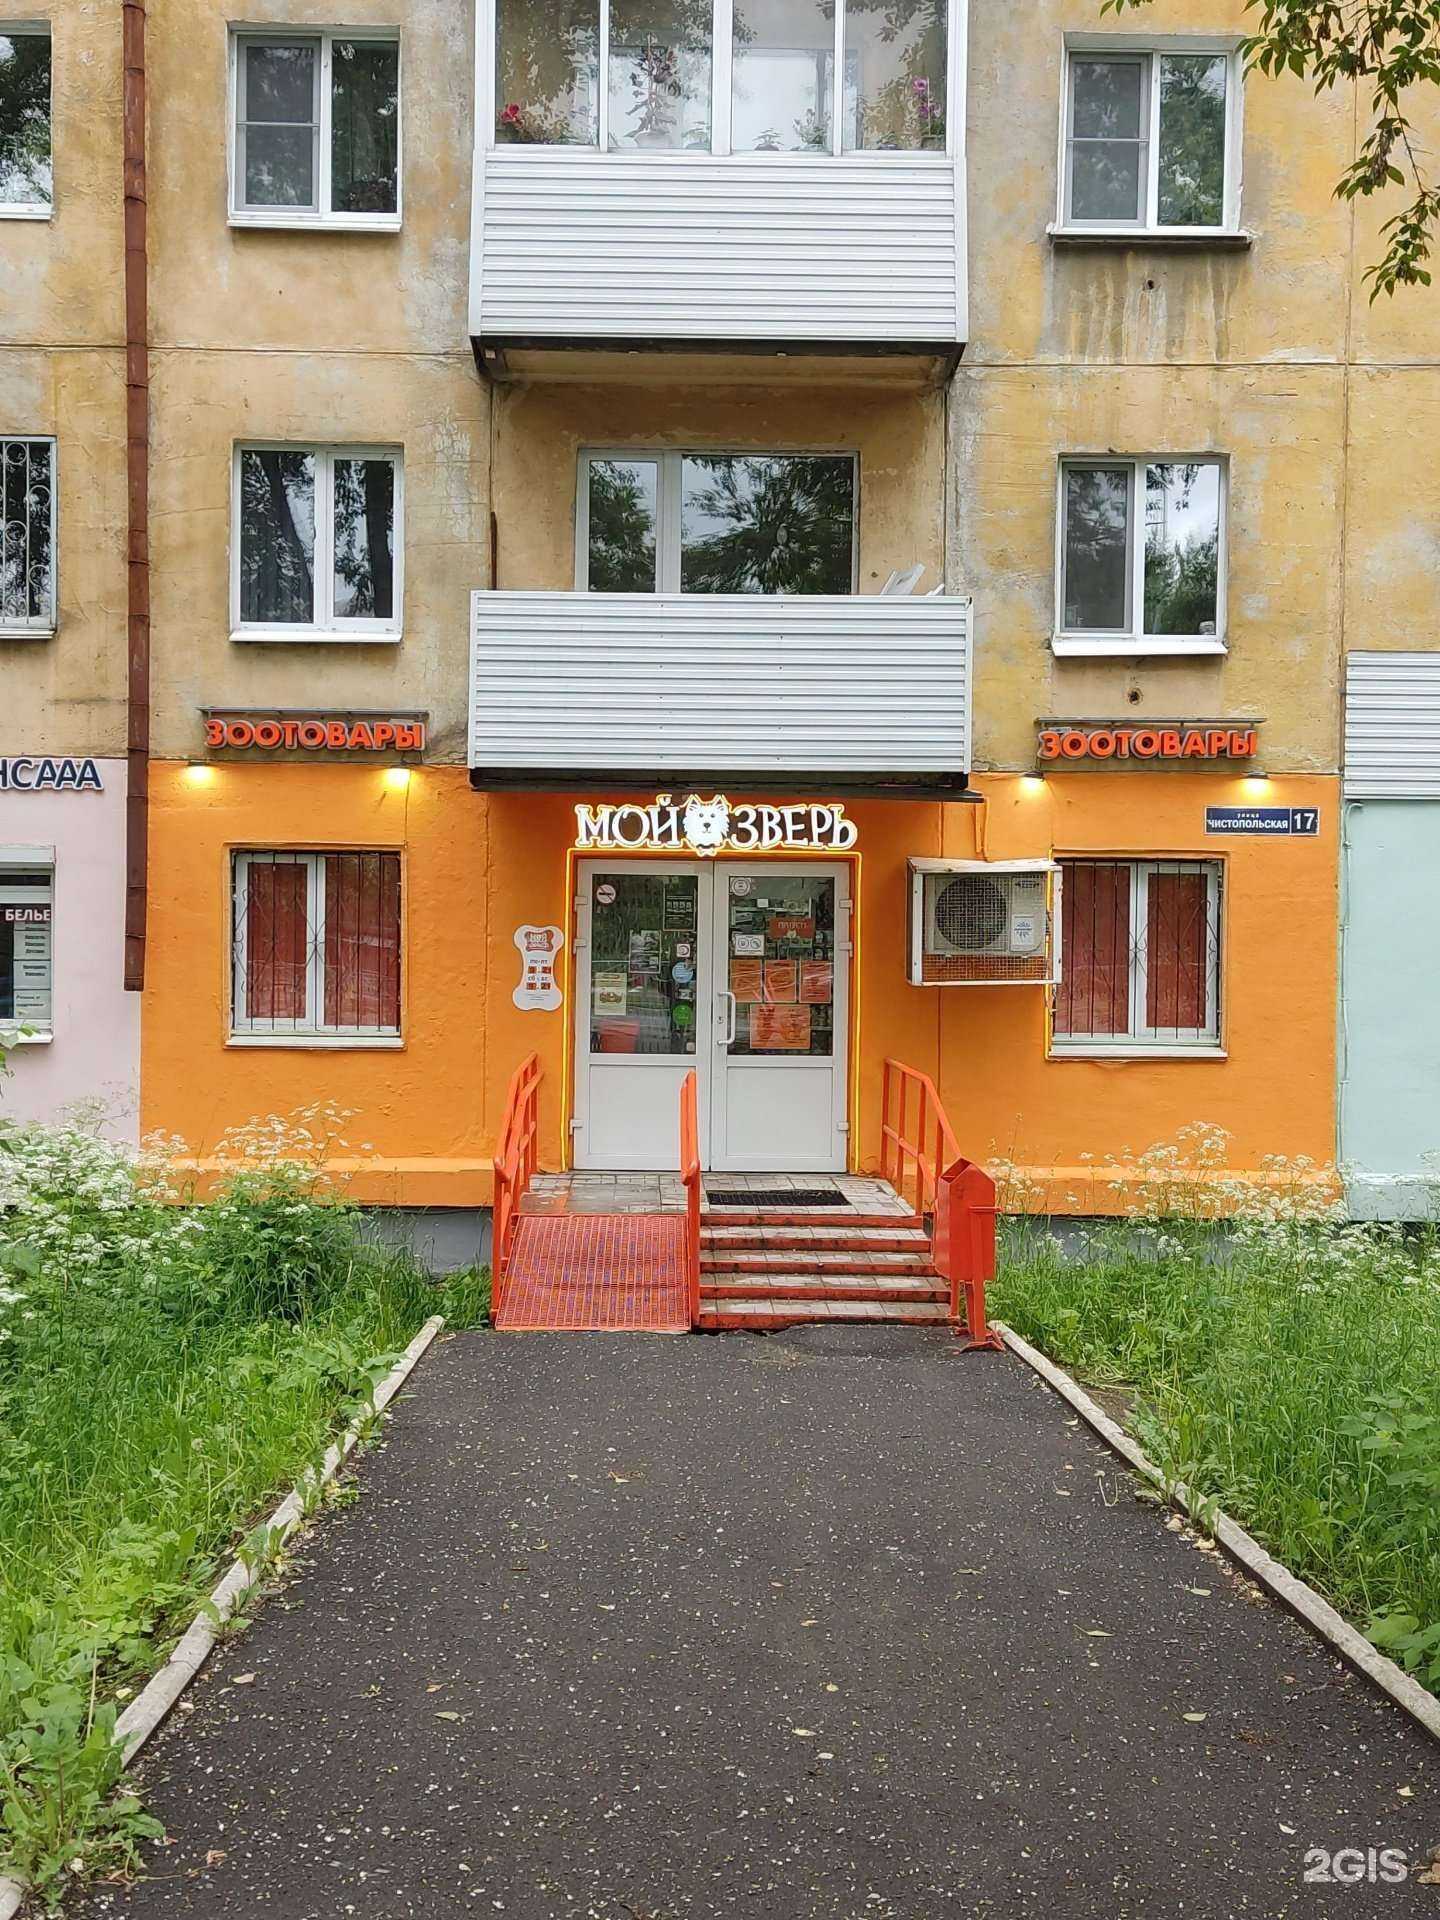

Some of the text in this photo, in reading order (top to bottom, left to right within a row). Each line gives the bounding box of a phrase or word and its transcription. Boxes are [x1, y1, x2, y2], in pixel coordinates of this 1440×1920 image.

[204, 718, 424, 750] ЗООТОВАРЫ
[1038, 730, 1259, 759] ЗООТОВАРЫ
[575, 794, 858, 850] МОЙ ЗВЕРЬ
[1206, 812, 1315, 830] ЧИСТОПОЛЬСКАЯ 17
[5, 908, 51, 922] БЕЛЬЕ
